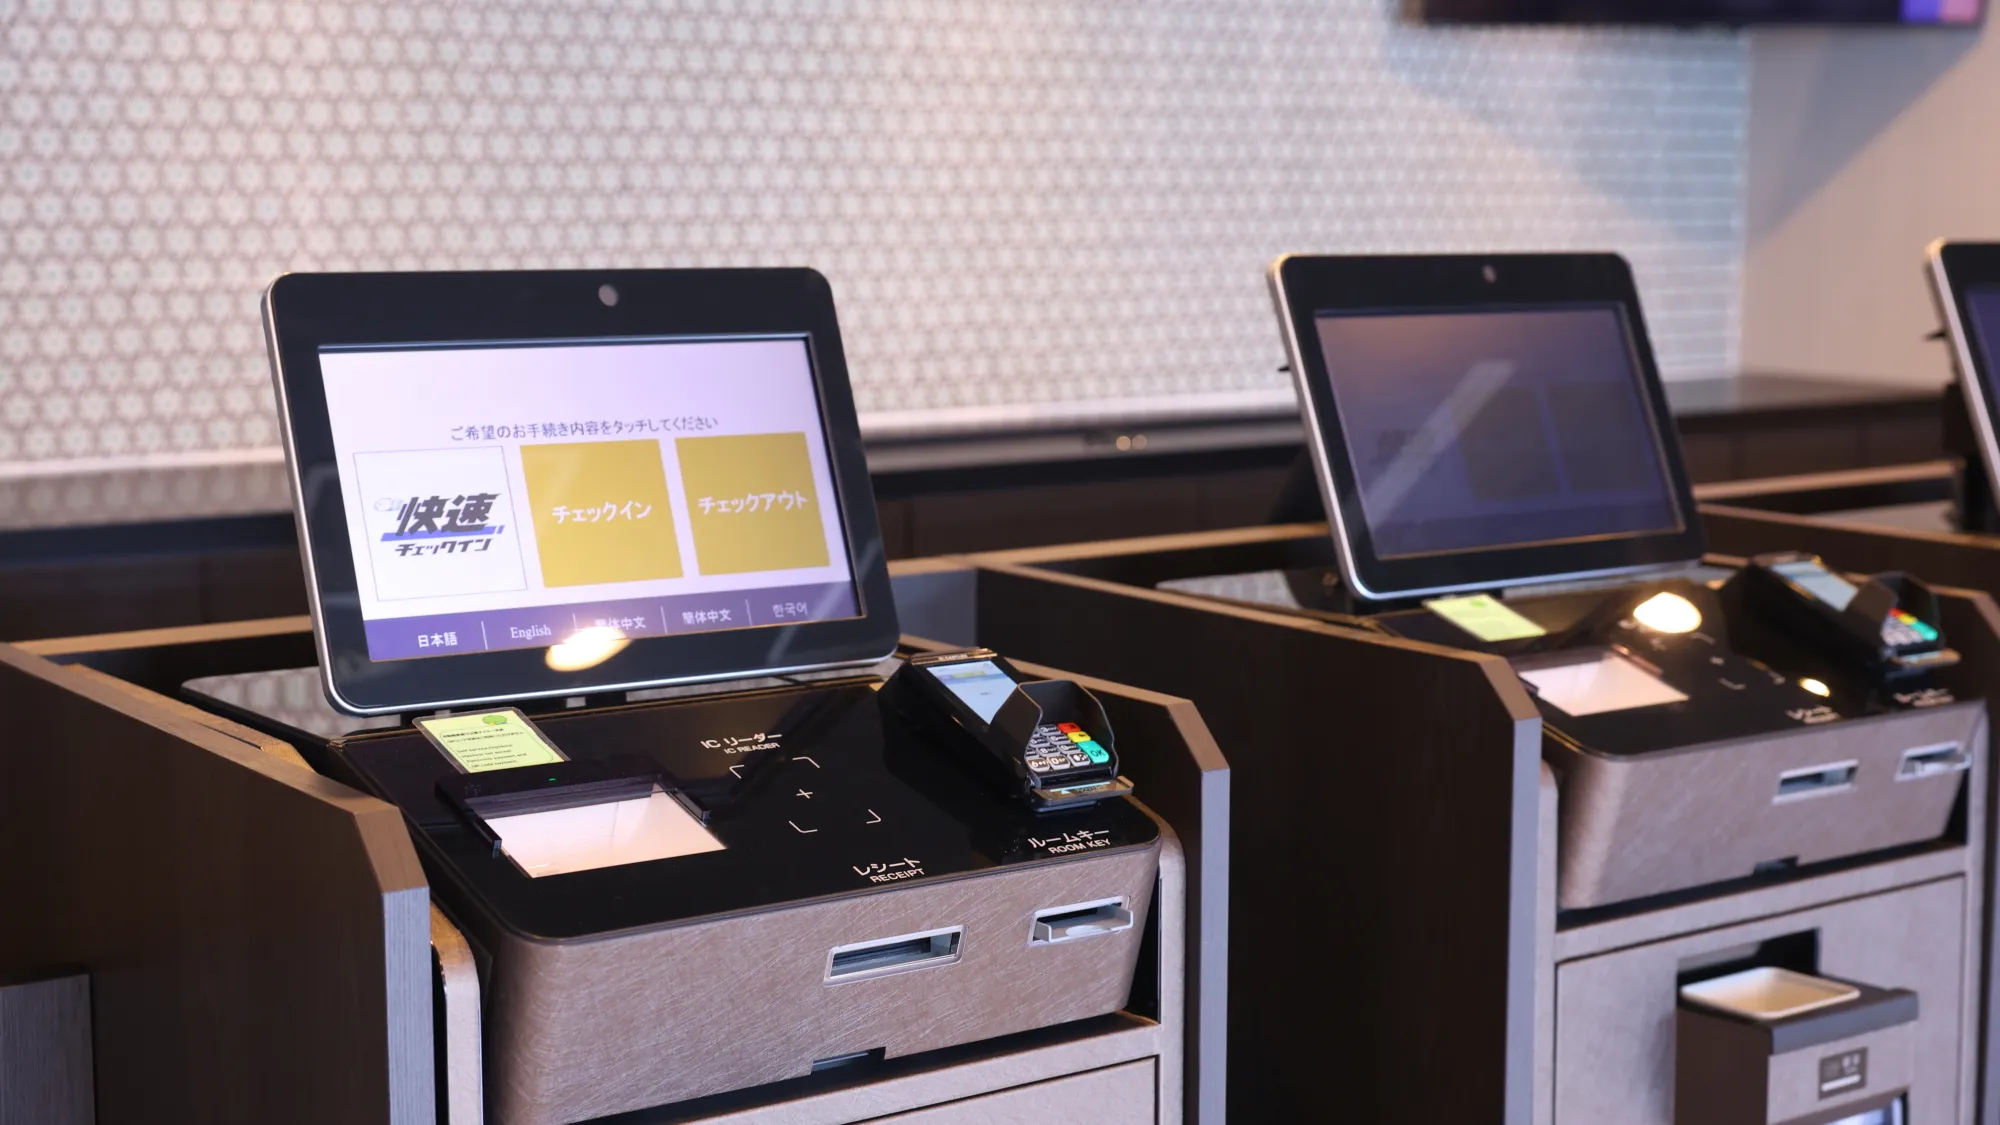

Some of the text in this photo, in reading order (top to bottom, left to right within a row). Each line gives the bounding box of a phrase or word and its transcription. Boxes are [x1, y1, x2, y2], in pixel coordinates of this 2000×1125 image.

[451, 416, 718, 441] ご希望のお手続き内容をタッチしてください
[698, 490, 808, 515] チェックアウト
[395, 493, 501, 536] 快速
[552, 501, 652, 524] チェックイン
[395, 538, 492, 556] チェックイン
[772, 602, 809, 618] 한국어
[417, 632, 458, 648] 日本語
[510, 624, 552, 640] English
[700, 732, 782, 749] IC リーダー
[737, 742, 780, 753] READER
[1090, 749, 1105, 757] OK
[1028, 830, 1109, 848] ルームキー
[1048, 838, 1111, 854] ROOM KEY
[852, 857, 920, 876] レシート
[869, 868, 925, 883] RECEIPT
